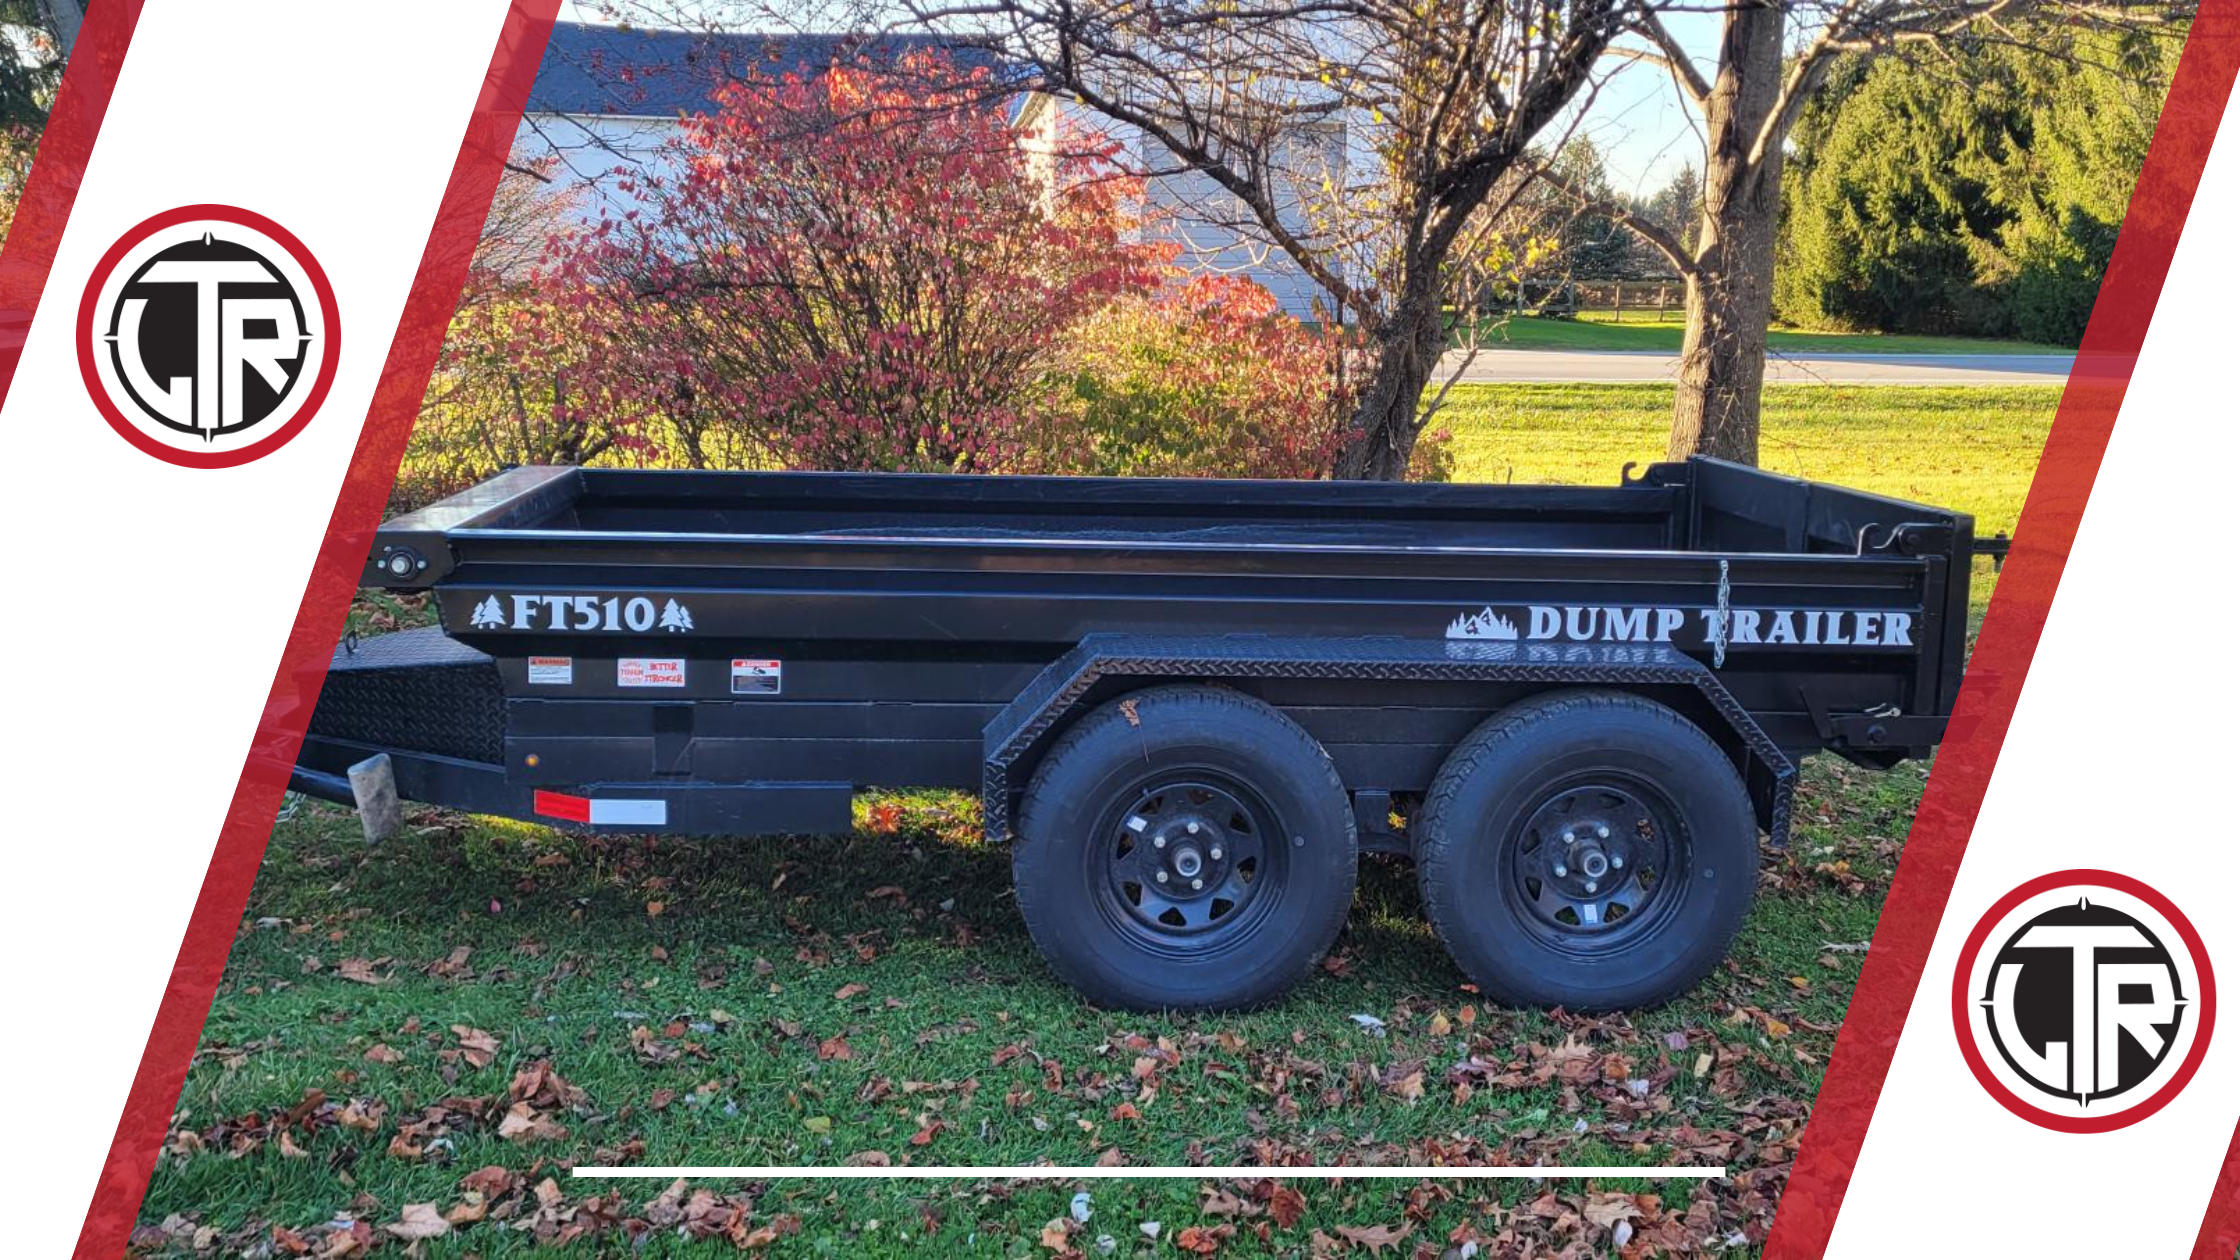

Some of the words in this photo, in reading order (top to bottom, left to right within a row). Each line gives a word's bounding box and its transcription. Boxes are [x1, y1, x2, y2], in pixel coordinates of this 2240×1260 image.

[511, 595, 655, 631] FT510
[1526, 606, 1684, 641] DUMP
[1701, 609, 1913, 645] TRAILER
